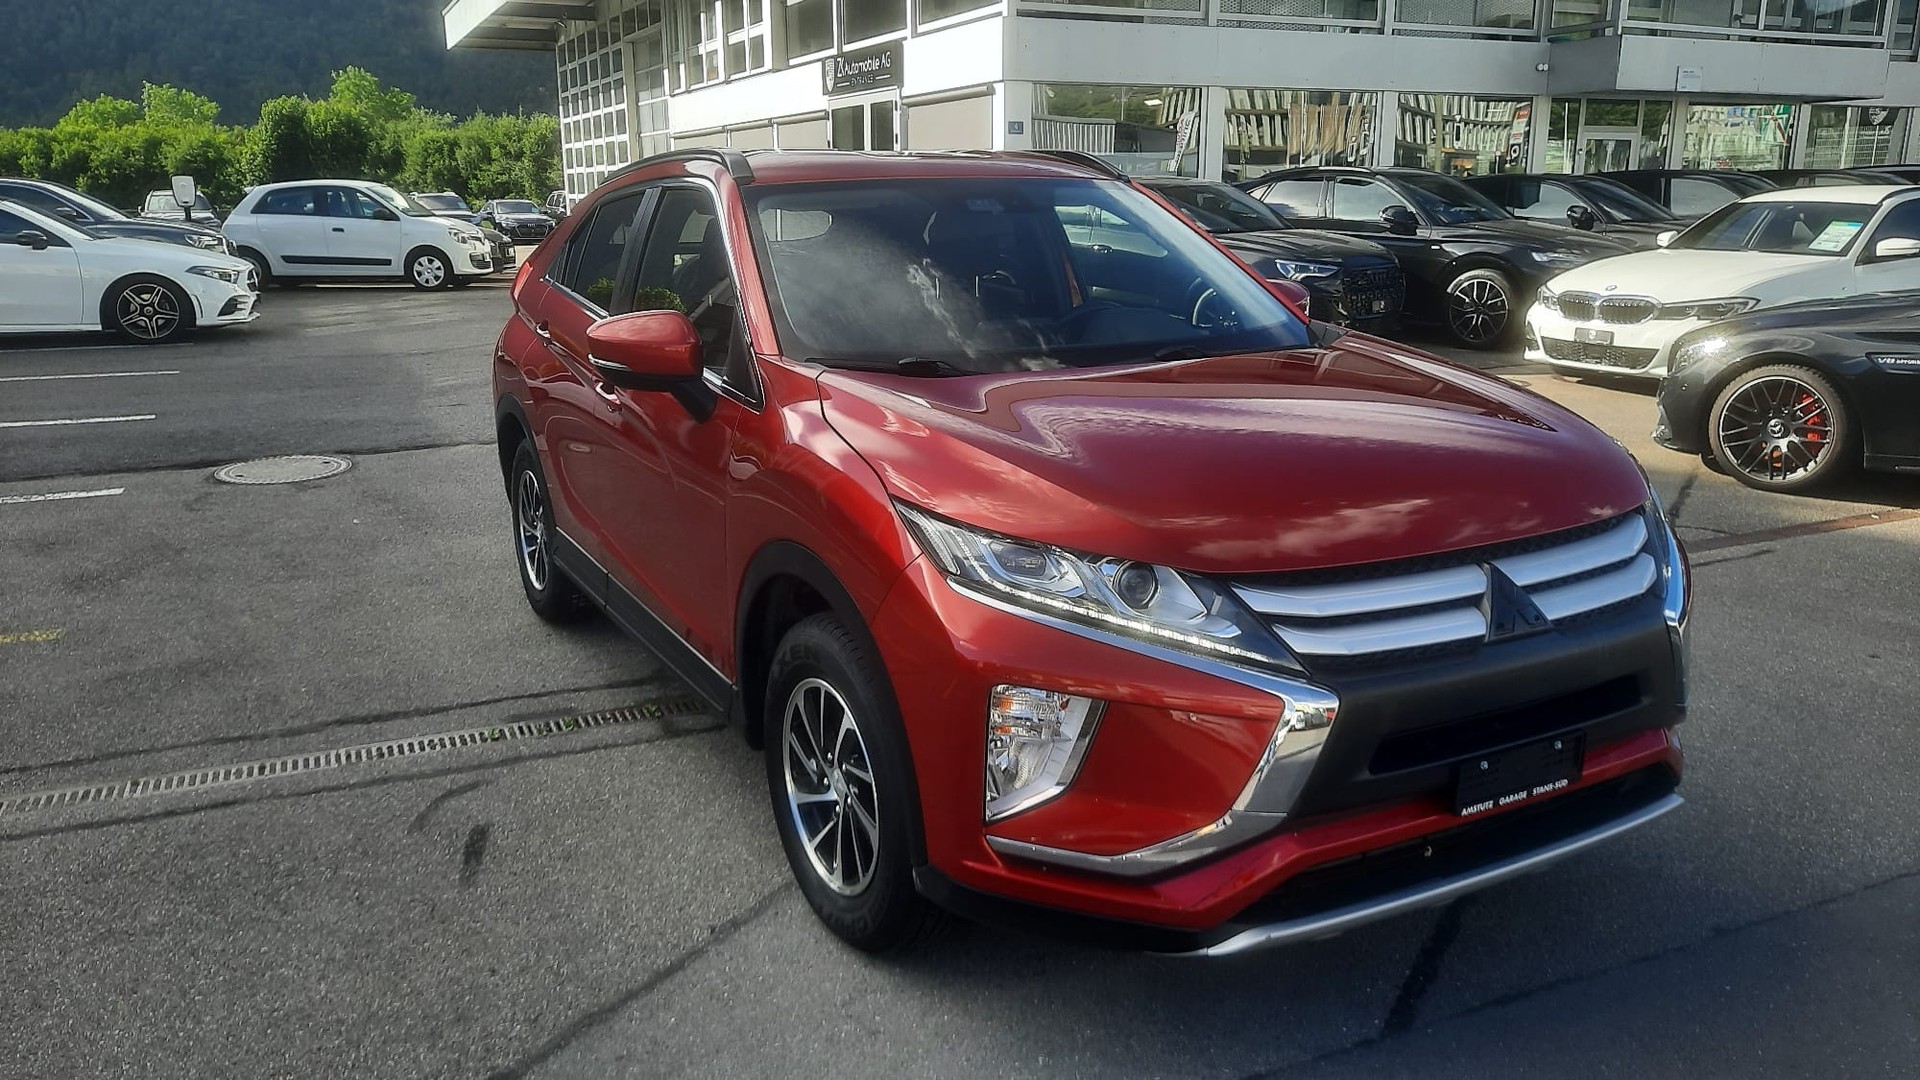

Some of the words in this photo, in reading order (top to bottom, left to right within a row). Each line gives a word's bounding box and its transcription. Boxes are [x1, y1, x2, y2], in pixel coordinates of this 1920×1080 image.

[845, 55, 880, 75] Automobile
[881, 51, 891, 68] AG
[1461, 800, 1494, 816] AMSTUTZ
[1498, 790, 1527, 806] GARAGE
